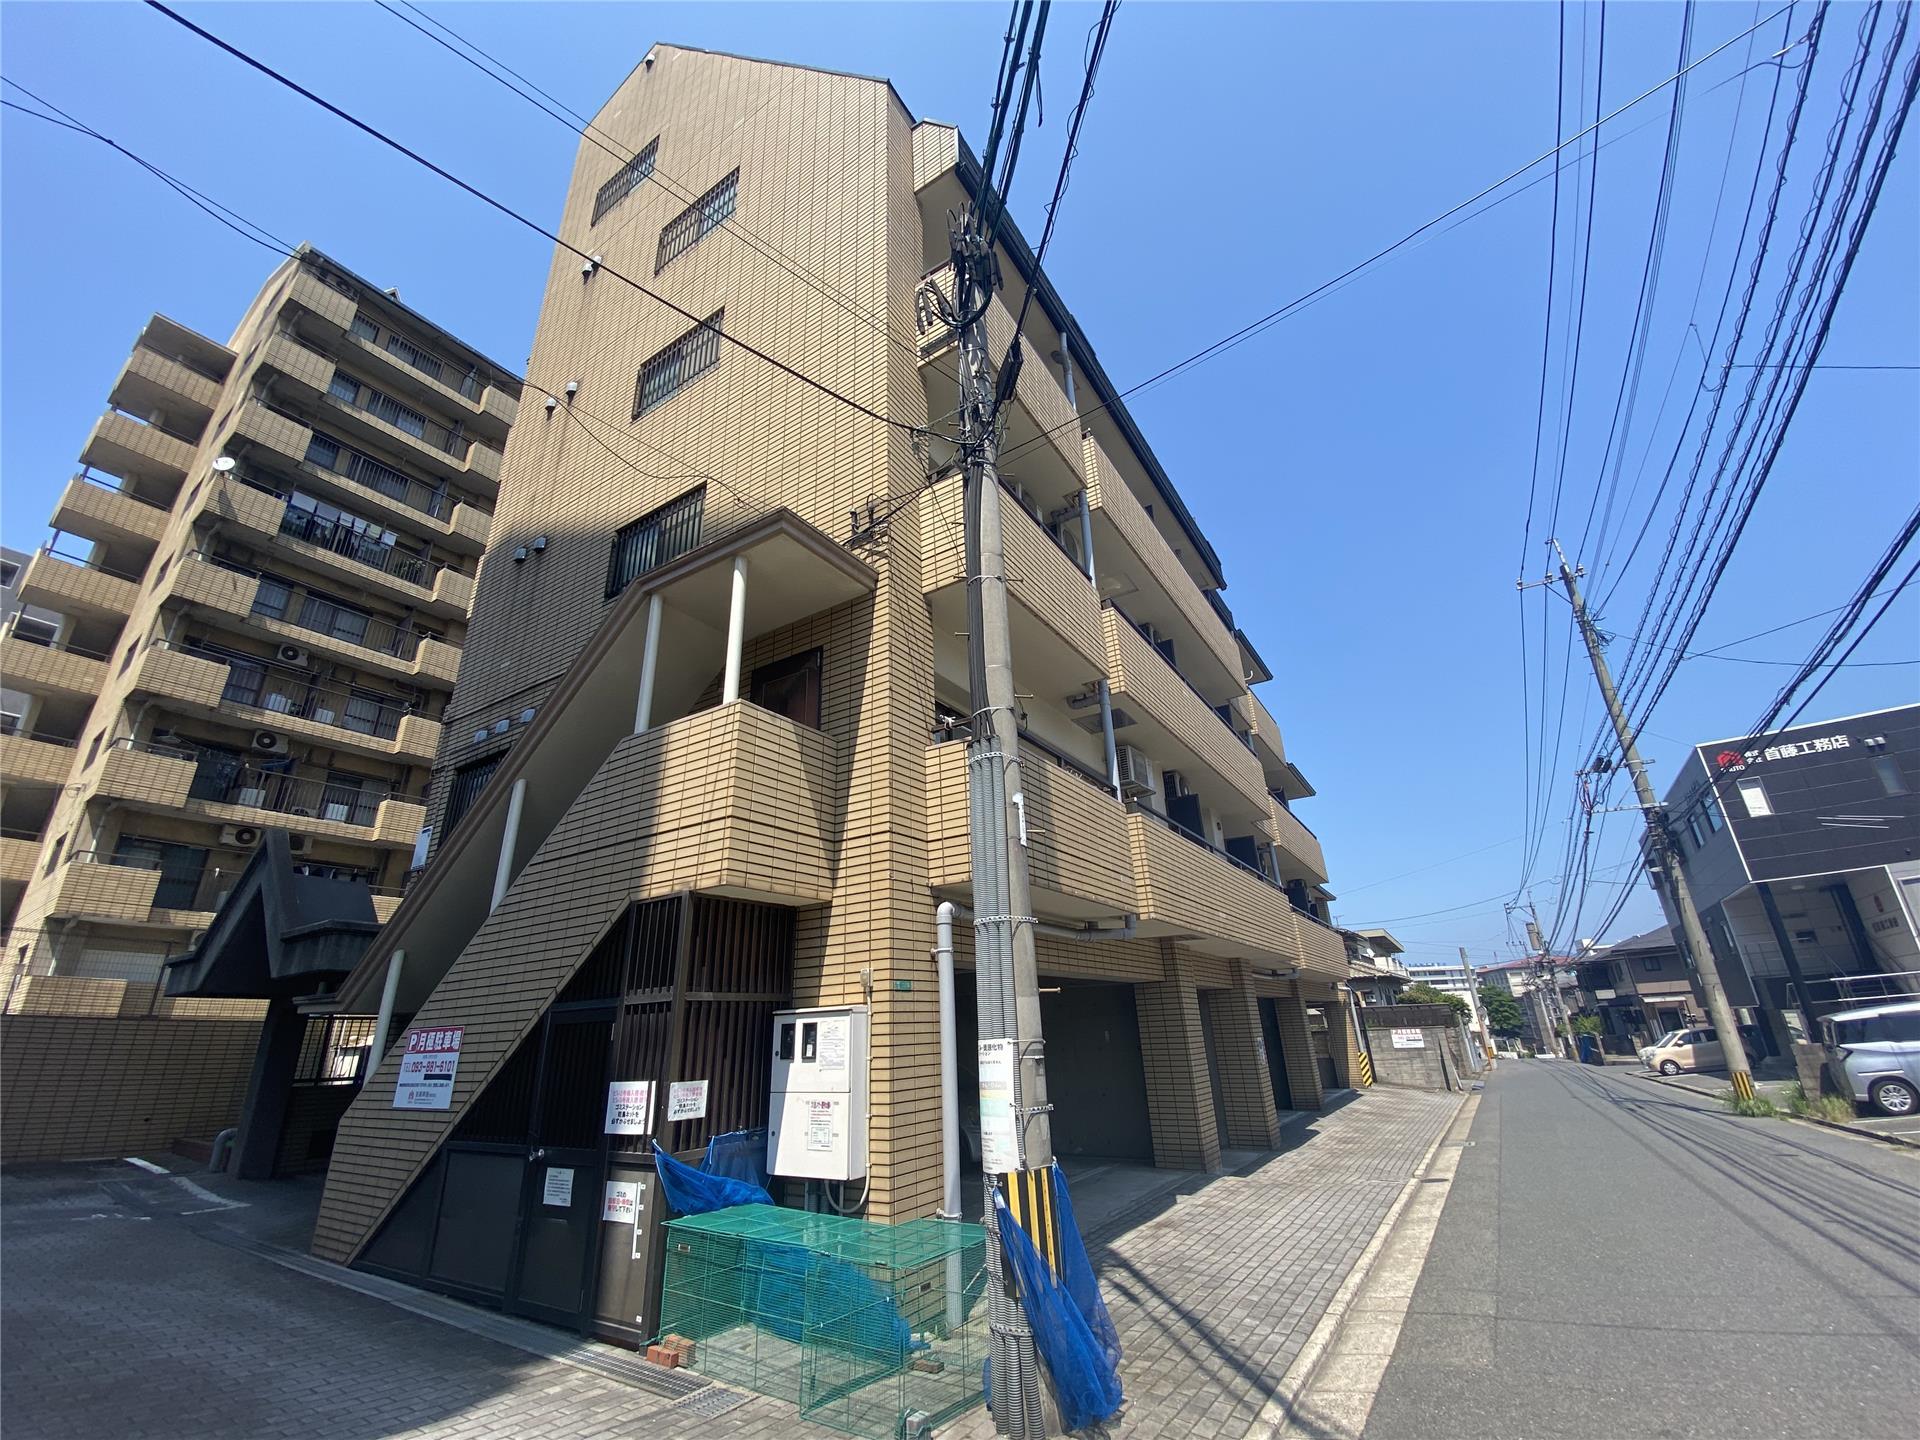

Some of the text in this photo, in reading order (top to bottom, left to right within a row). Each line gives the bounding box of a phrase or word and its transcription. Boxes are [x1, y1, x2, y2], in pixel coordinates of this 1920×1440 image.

[1764, 735, 1850, 760] 首藤工務店
